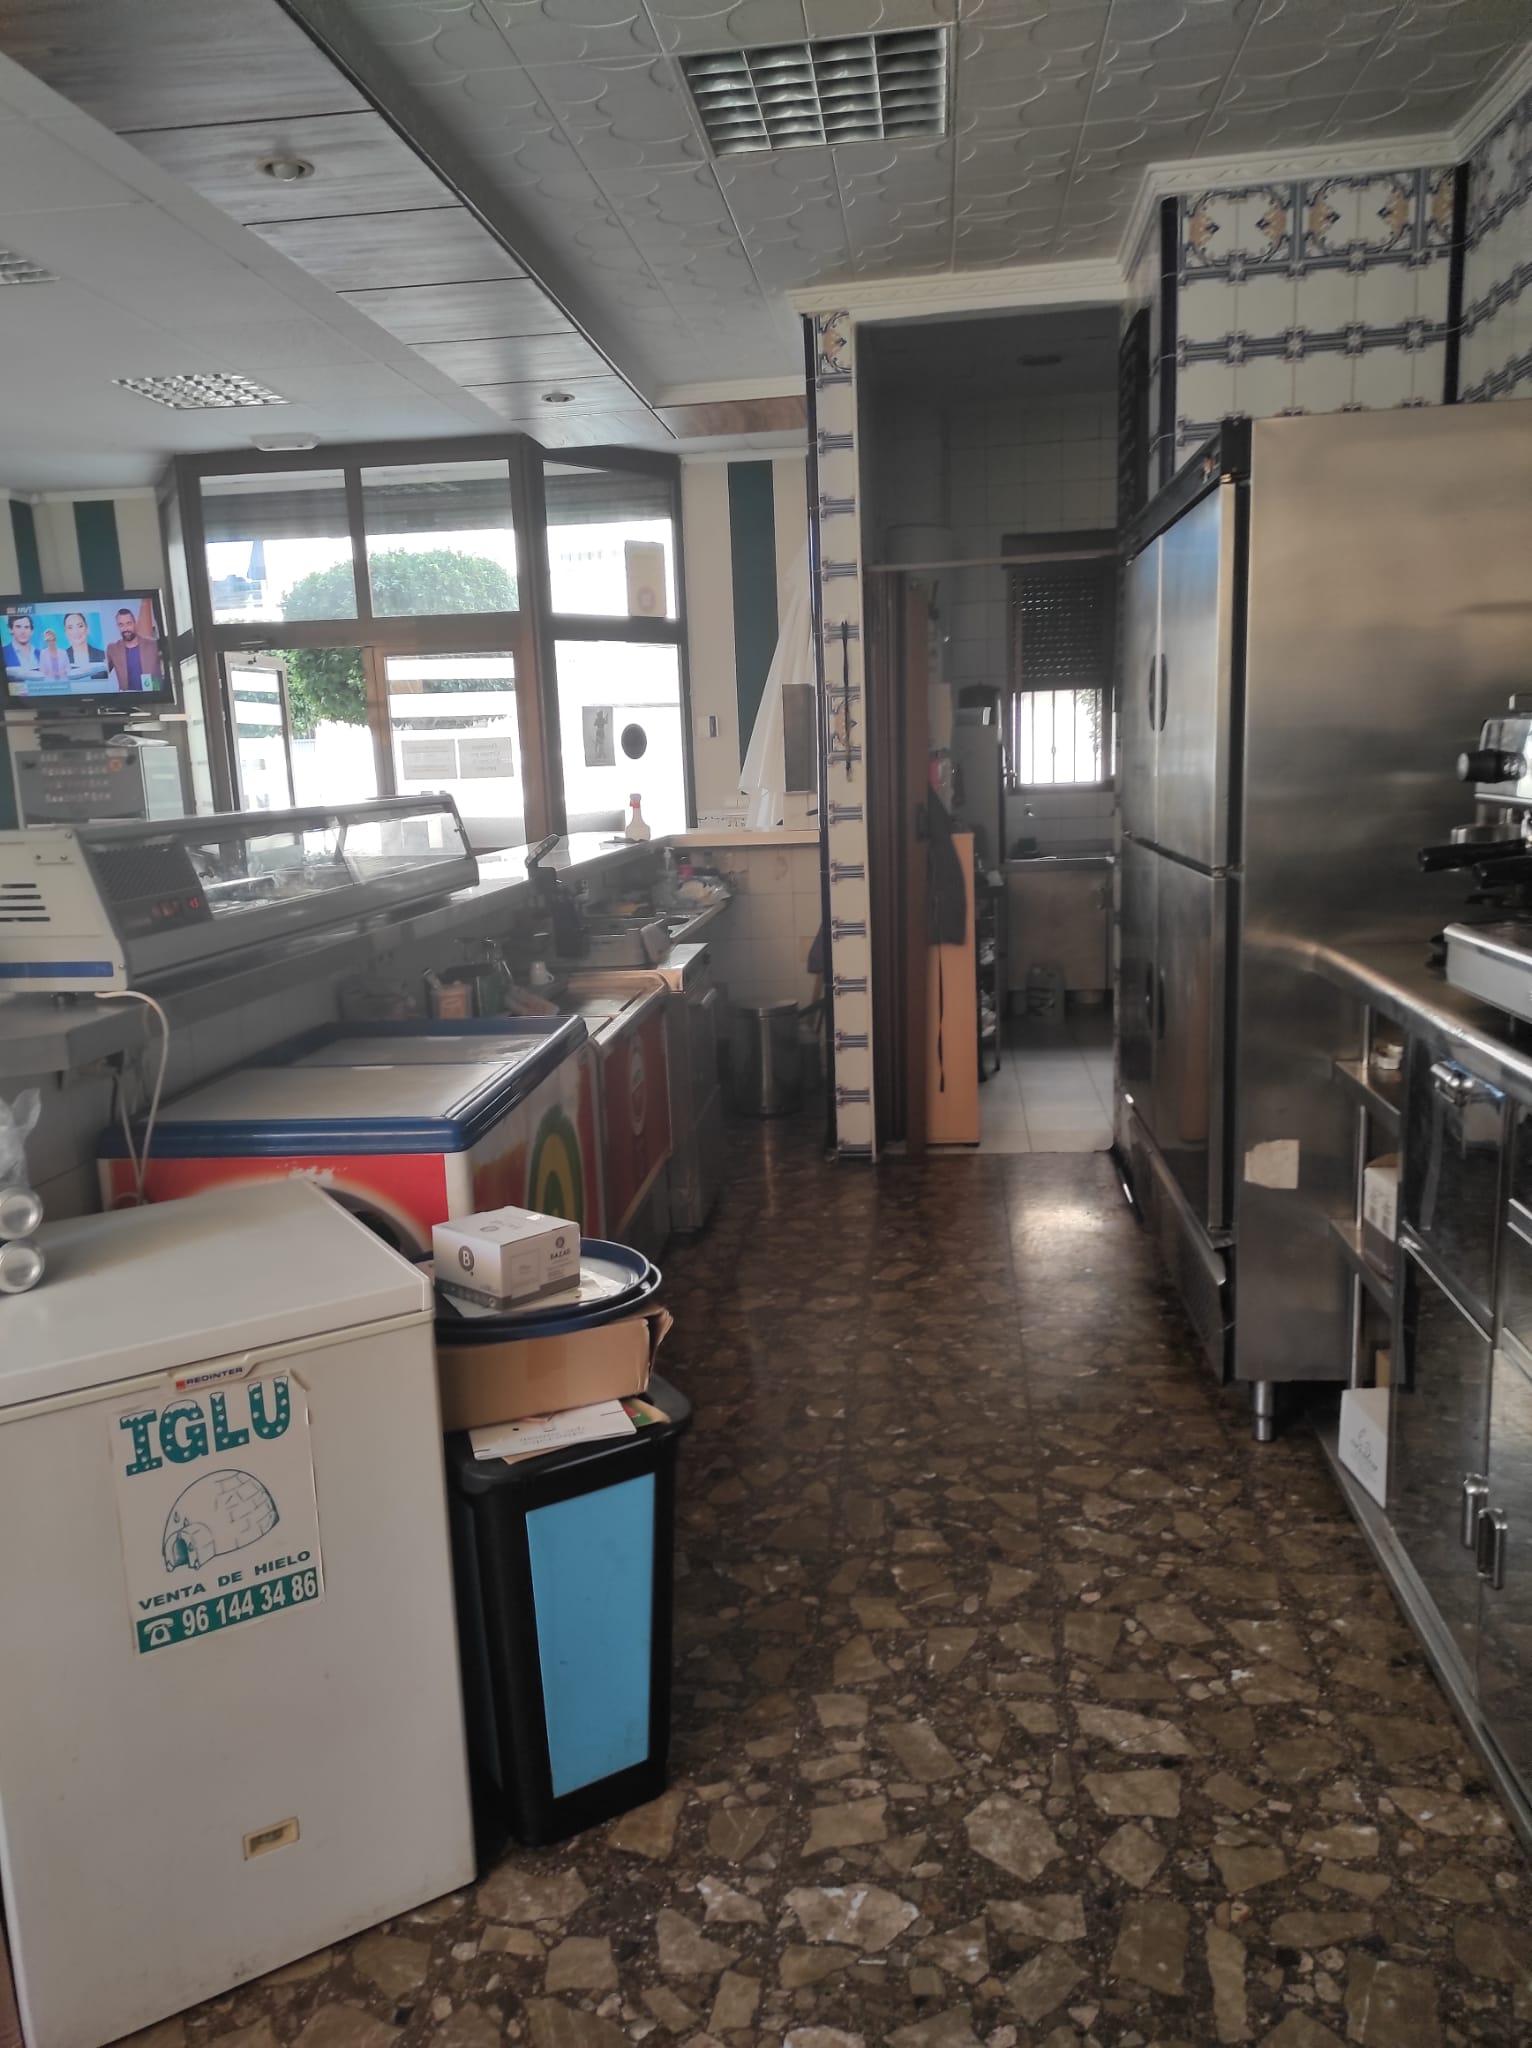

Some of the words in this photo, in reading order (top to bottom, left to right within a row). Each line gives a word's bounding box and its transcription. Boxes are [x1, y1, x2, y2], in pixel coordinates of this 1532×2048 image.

[119, 1375, 291, 1477] IGLU
[138, 1583, 206, 1610] VENTA
[217, 1570, 243, 1588] DE
[254, 1550, 311, 1576] HIELO
[182, 1604, 209, 1636] 96
[216, 1589, 254, 1625] 144
[260, 1580, 286, 1611] 34
[291, 1570, 317, 1602] 86
